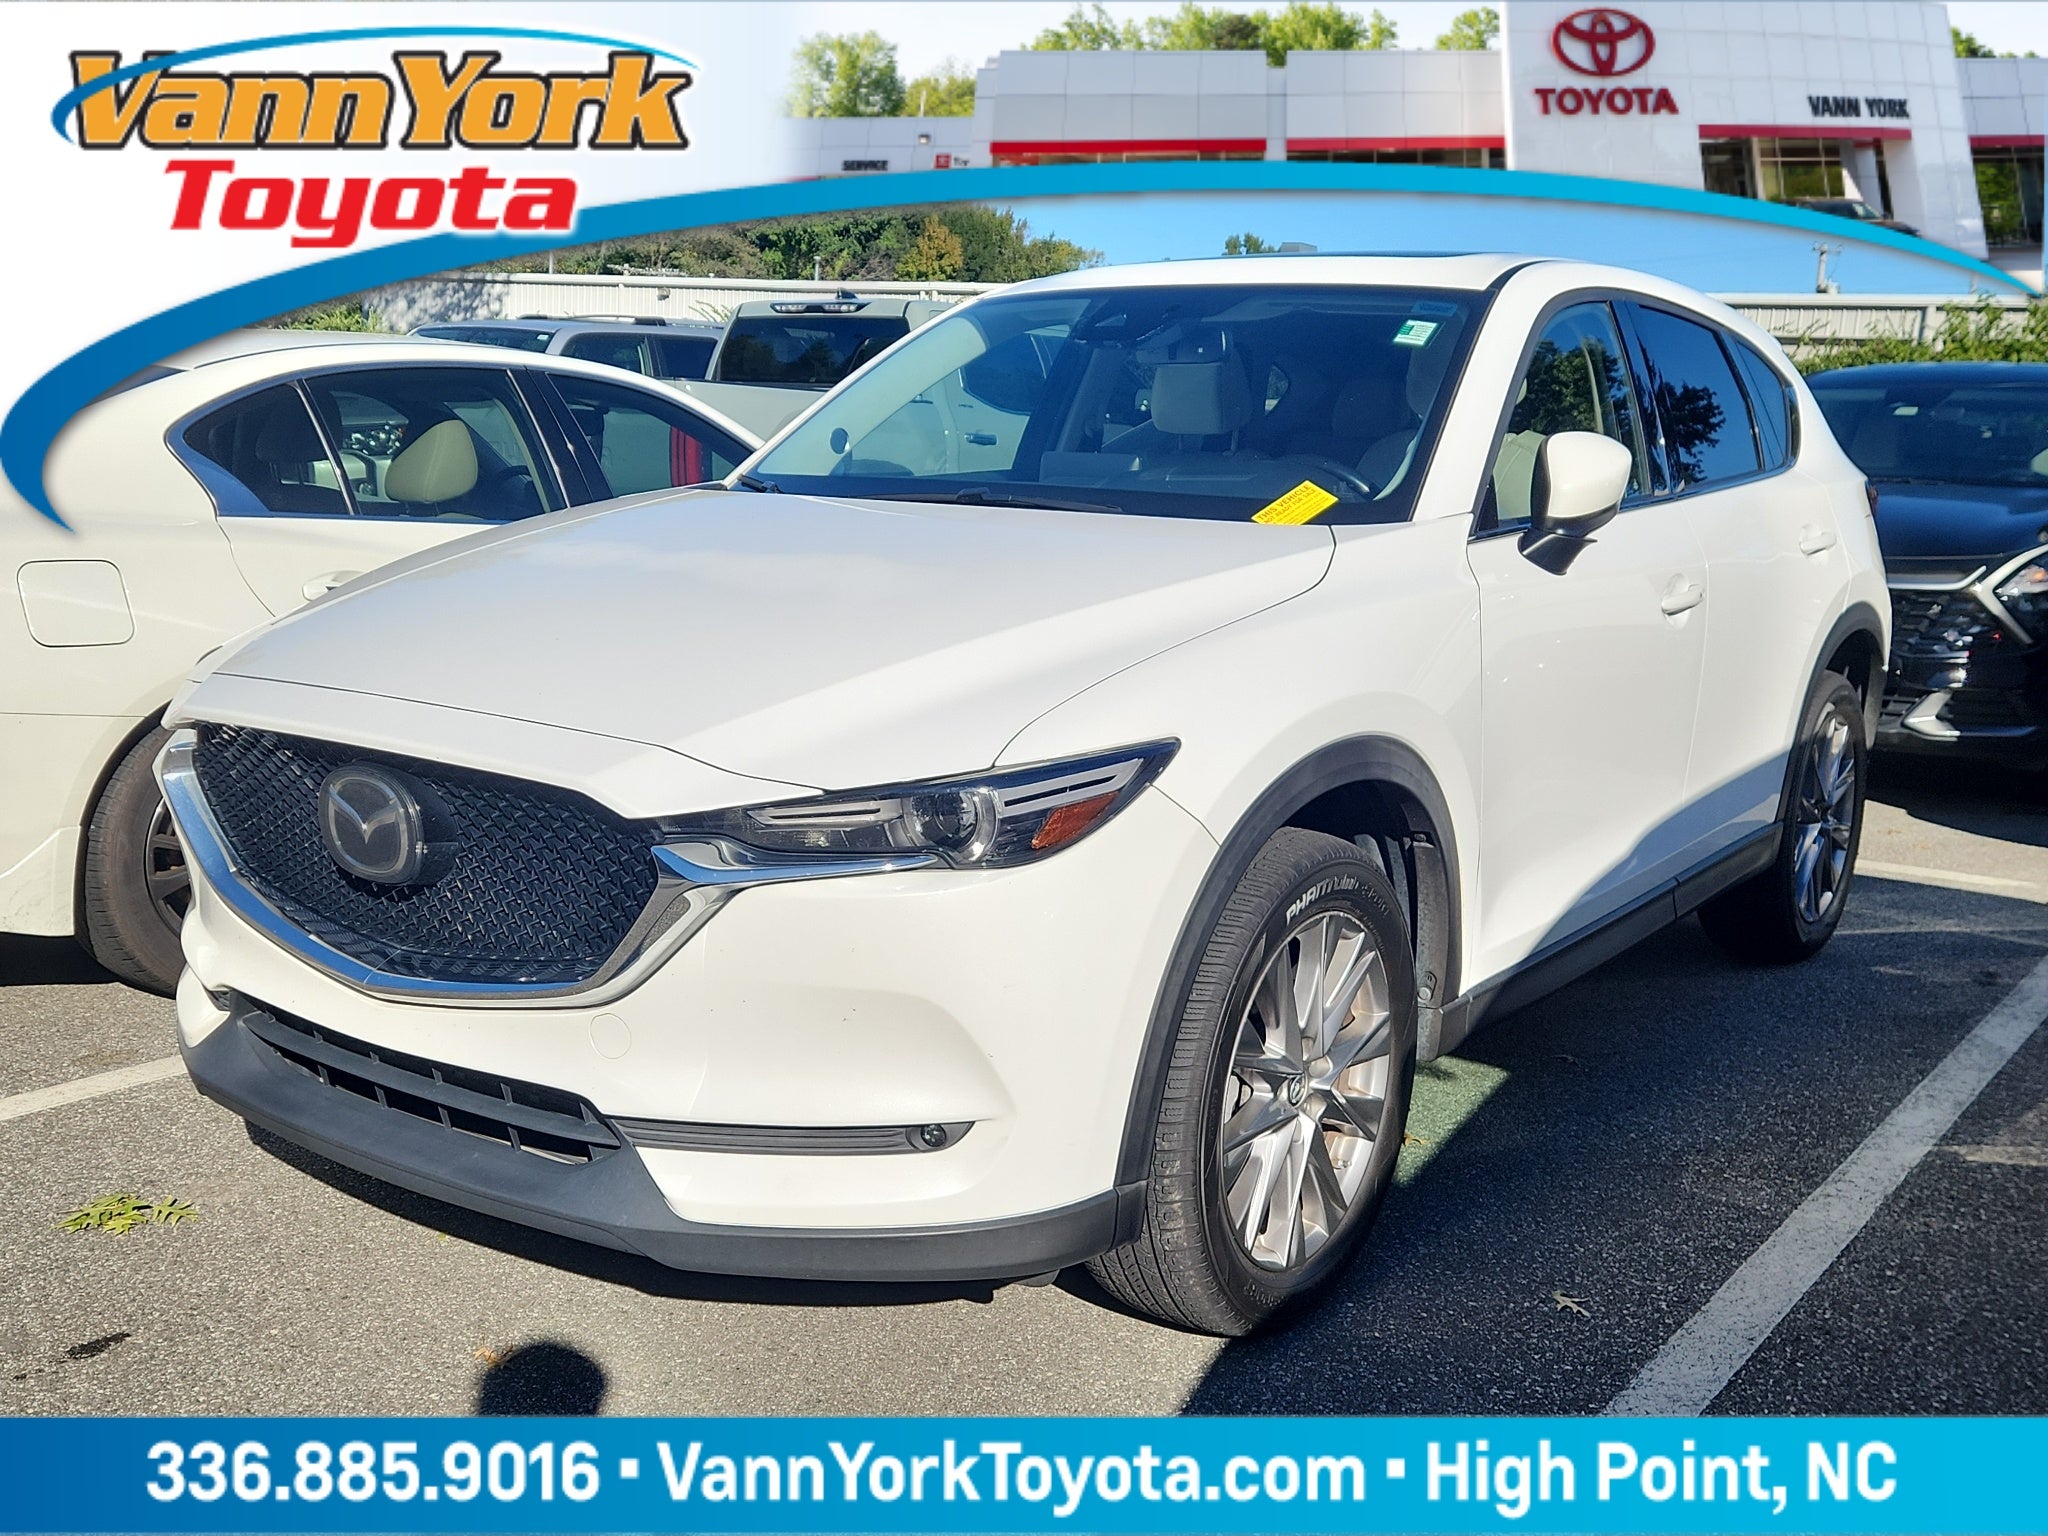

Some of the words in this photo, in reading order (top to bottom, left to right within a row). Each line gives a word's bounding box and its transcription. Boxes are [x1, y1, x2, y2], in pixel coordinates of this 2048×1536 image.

[1533, 87, 1679, 116] TOYOTA
[1807, 95, 1861, 118] VANN
[1864, 97, 1911, 119] YORK
[841, 160, 889, 172] SERVICE
[1256, 506, 1278, 521] THIS
[1276, 484, 1312, 507] VEHICLE
